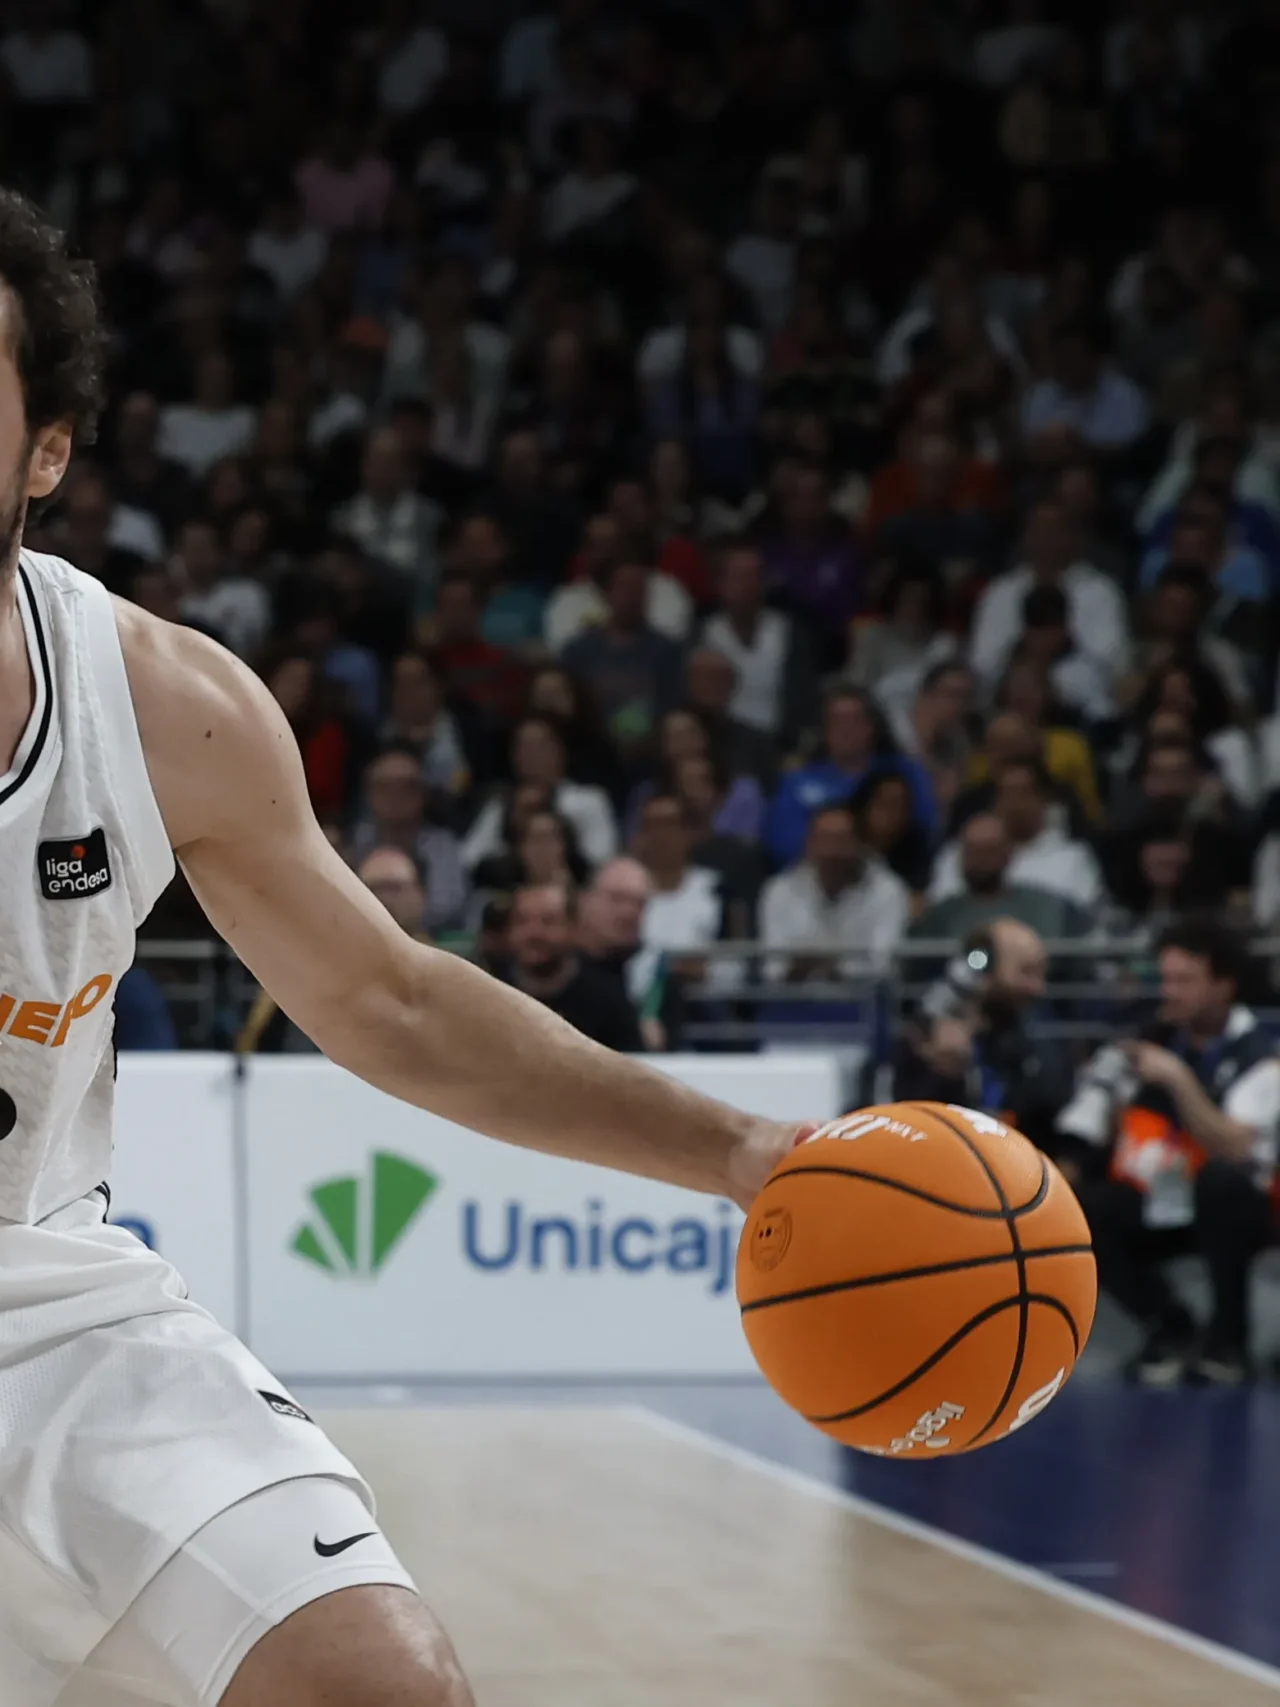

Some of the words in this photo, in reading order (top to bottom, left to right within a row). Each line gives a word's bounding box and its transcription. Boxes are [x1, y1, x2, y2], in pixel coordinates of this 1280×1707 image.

[46, 858, 82, 877] liga
[48, 868, 108, 893] endesa
[461, 1198, 737, 1296] Unicaj
